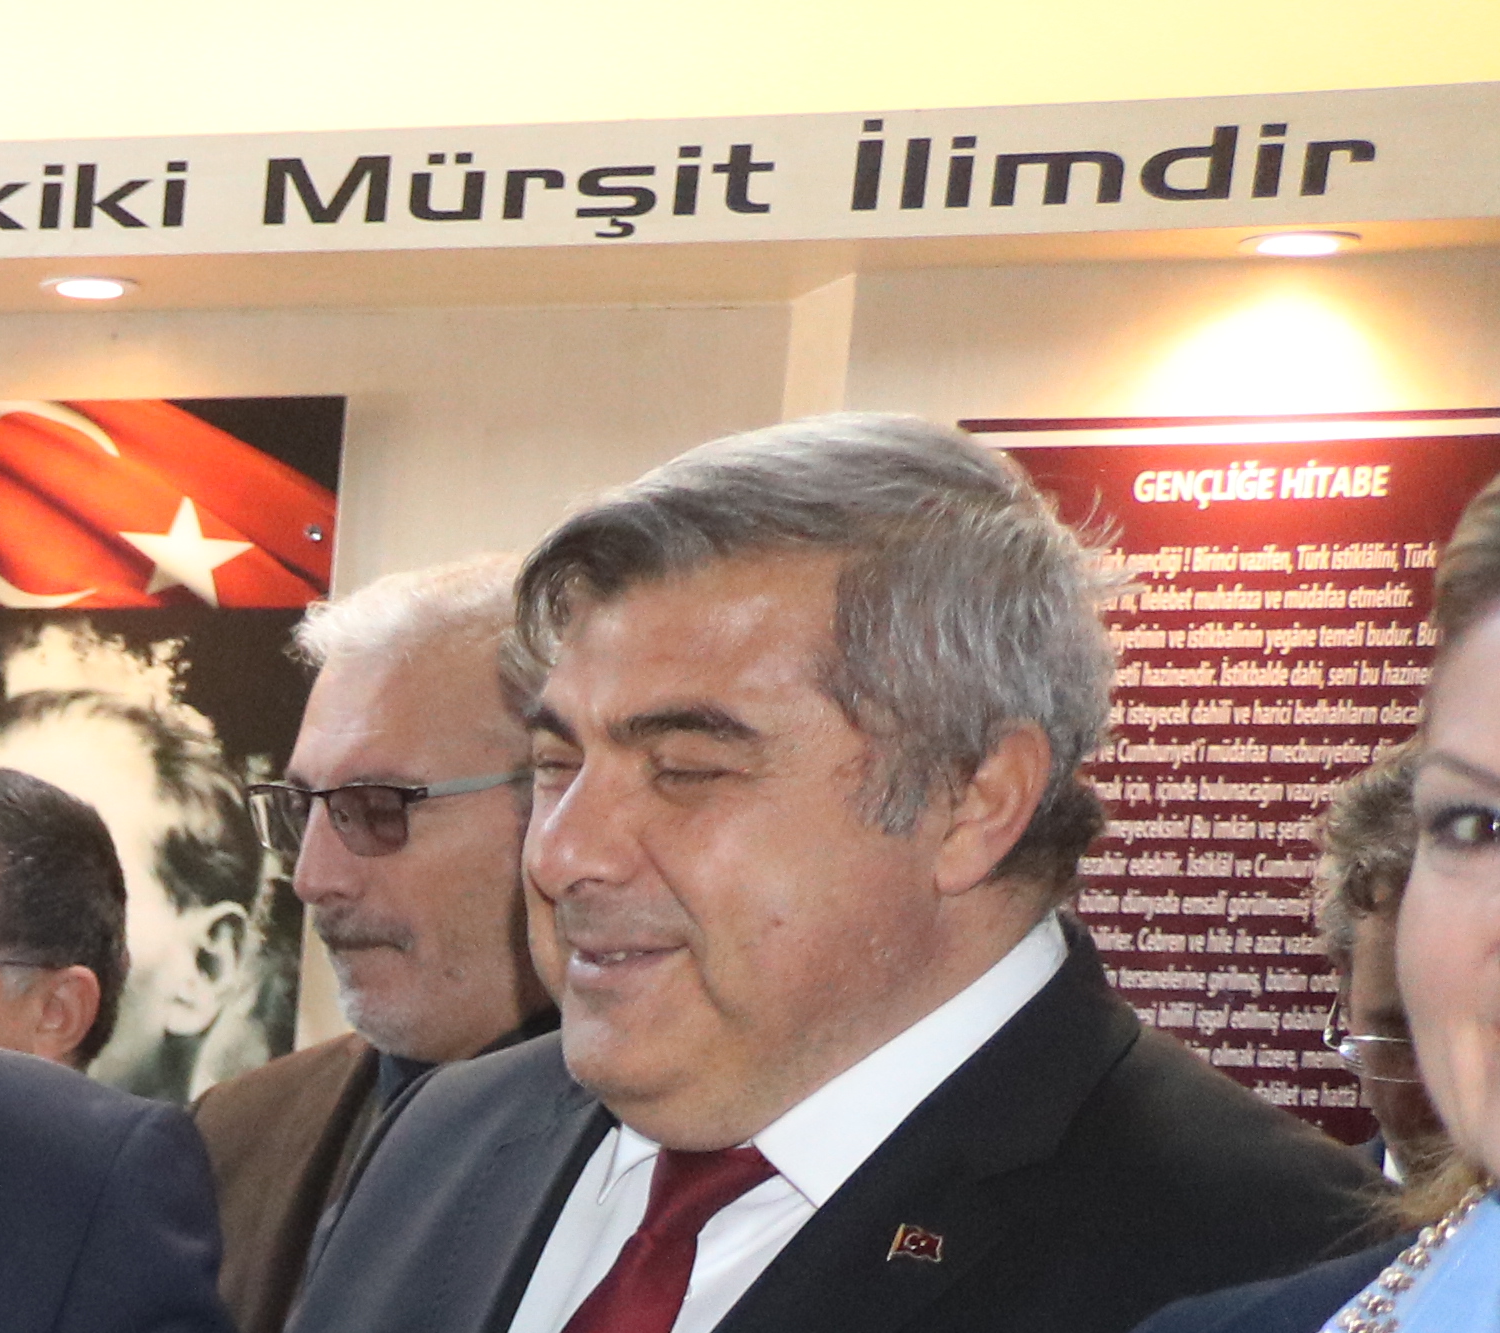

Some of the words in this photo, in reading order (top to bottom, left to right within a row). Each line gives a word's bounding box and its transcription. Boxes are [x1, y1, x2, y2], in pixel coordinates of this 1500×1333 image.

[262, 144, 777, 239] Mürşit
[849, 118, 1377, 213] İlimdir
[1133, 459, 1276, 511] GENÇLİĞE
[1280, 459, 1391, 500] HİTABE
[1297, 543, 1331, 570] Türk
[1403, 541, 1438, 568] Türk
[1264, 590, 1282, 609] ve
